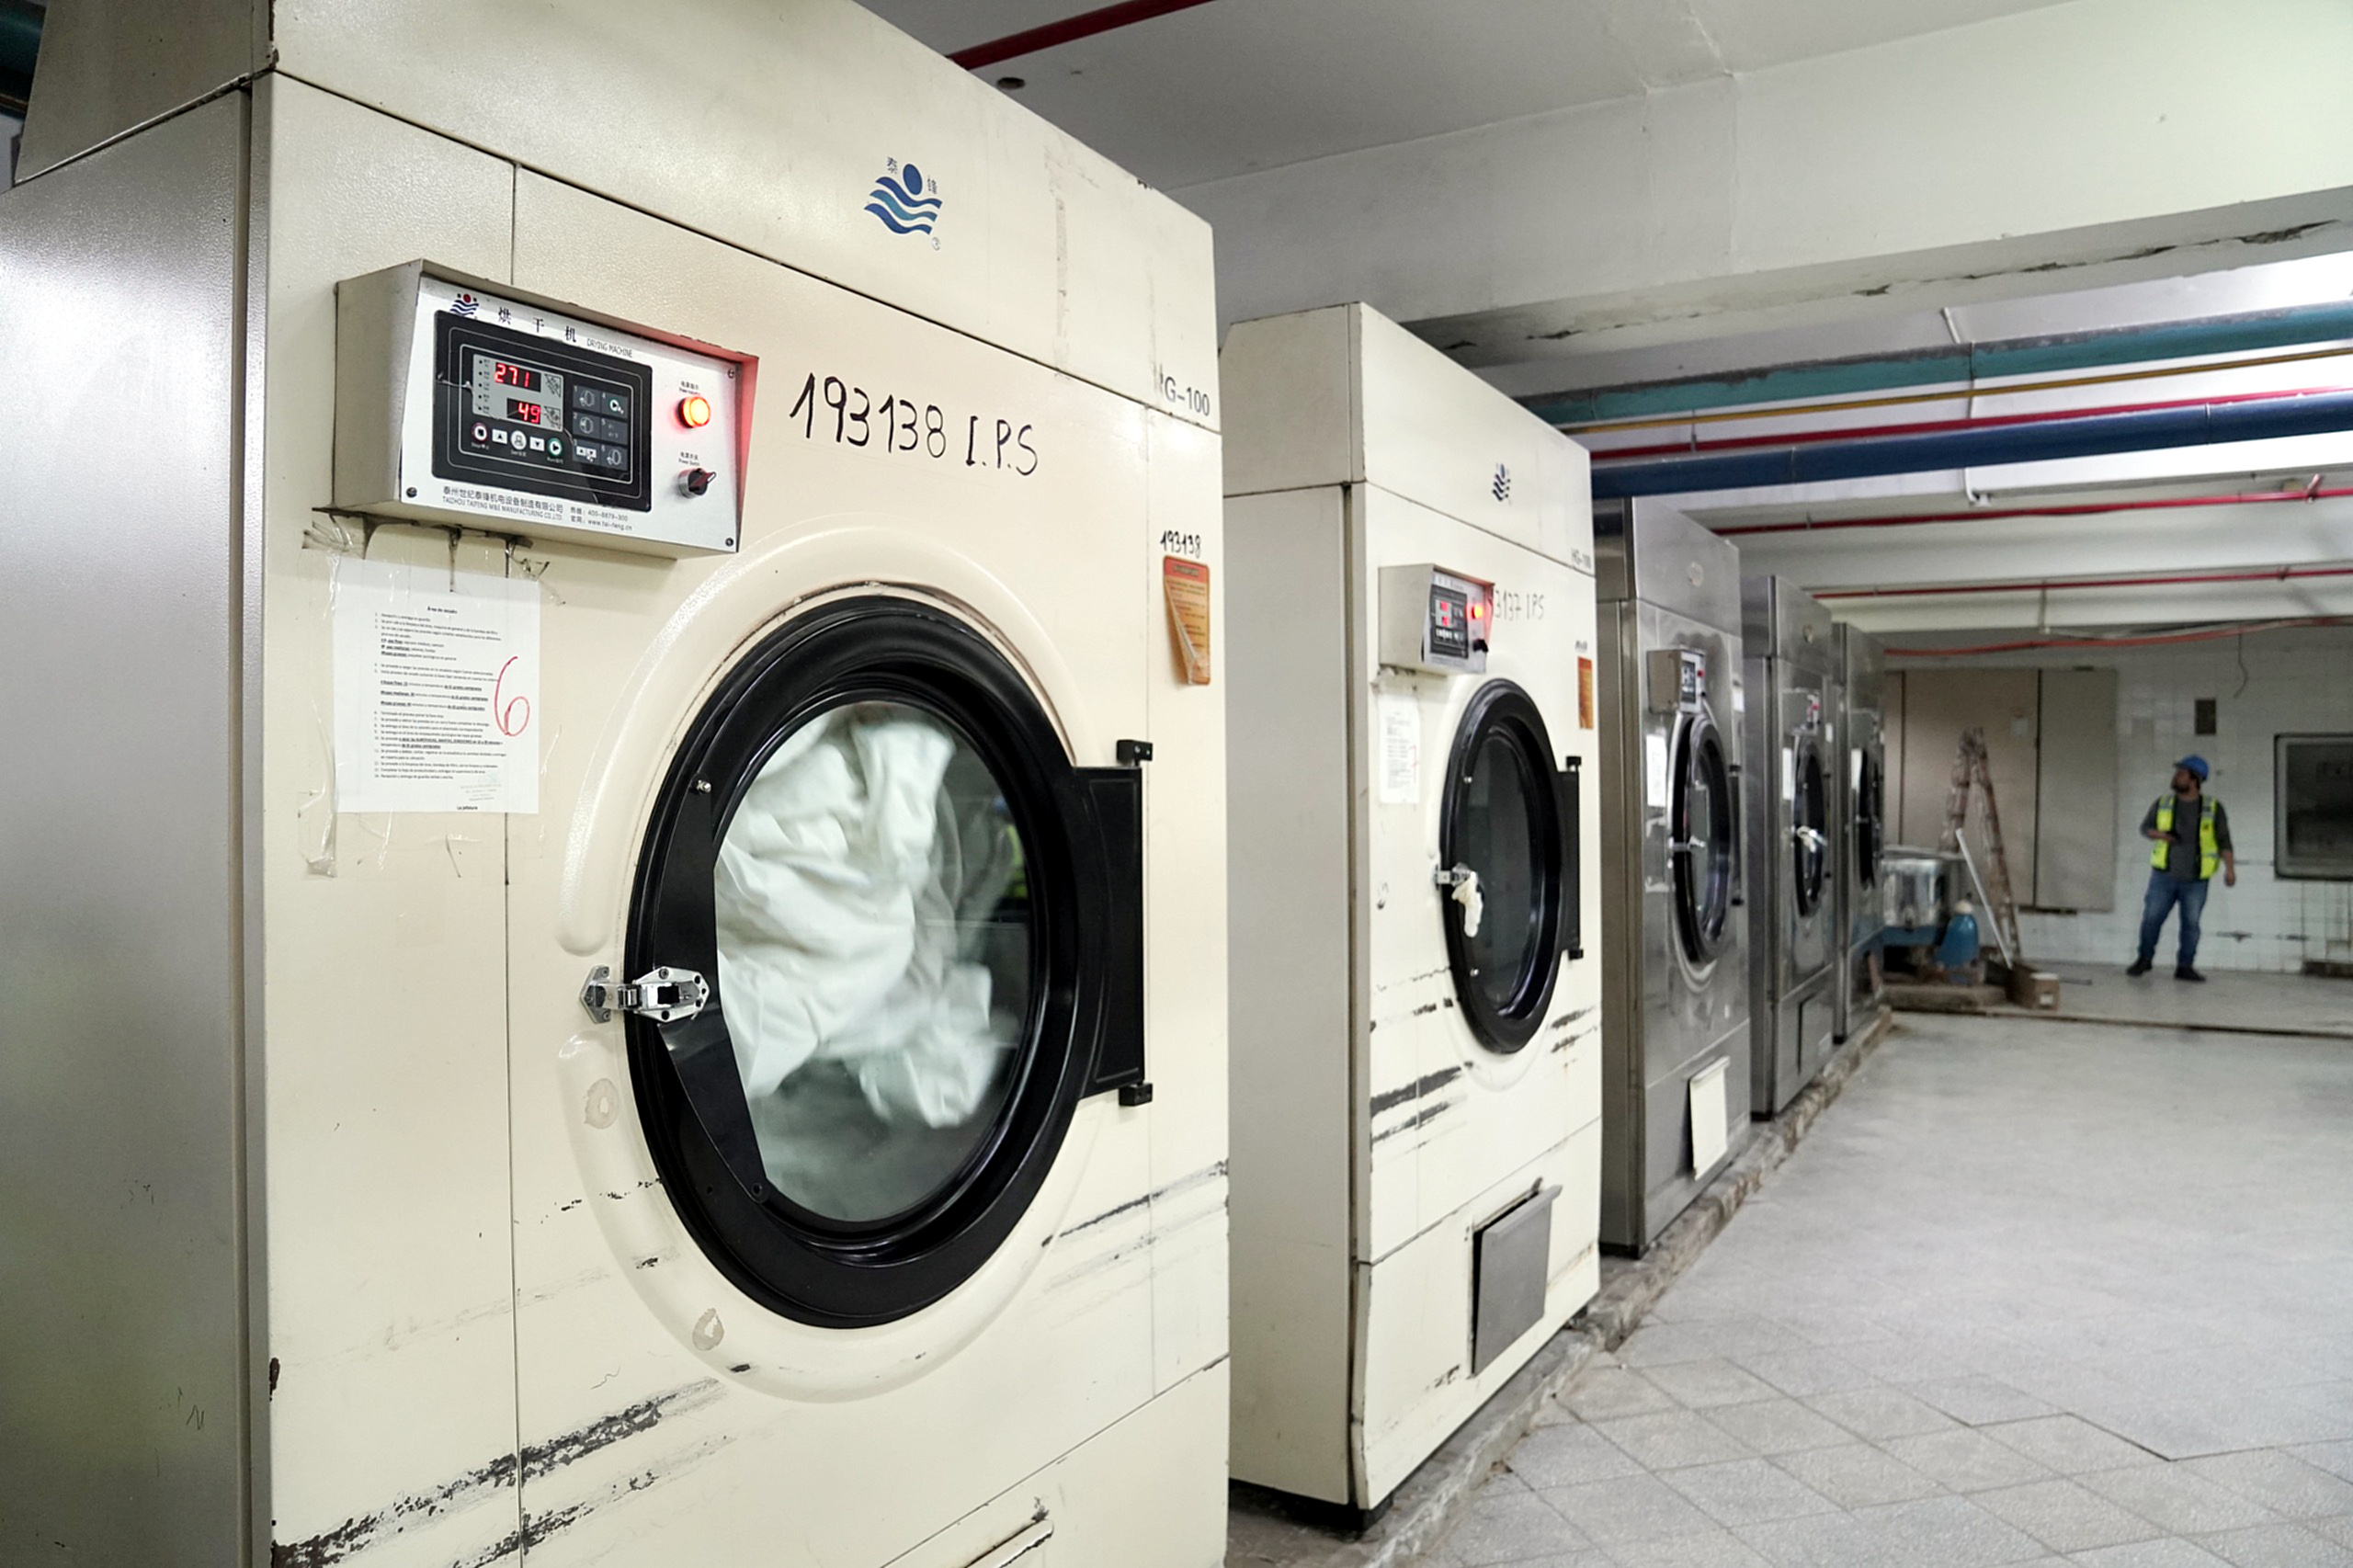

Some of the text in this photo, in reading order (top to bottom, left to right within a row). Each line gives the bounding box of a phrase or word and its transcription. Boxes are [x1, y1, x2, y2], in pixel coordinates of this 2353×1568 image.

[497, 306, 577, 343] 烘干机
[586, 337, 633, 358] DRYING MACHINE
[494, 363, 530, 388] 271
[517, 402, 542, 425] 49
[789, 372, 947, 459] 193138
[494, 655, 530, 736] 6
